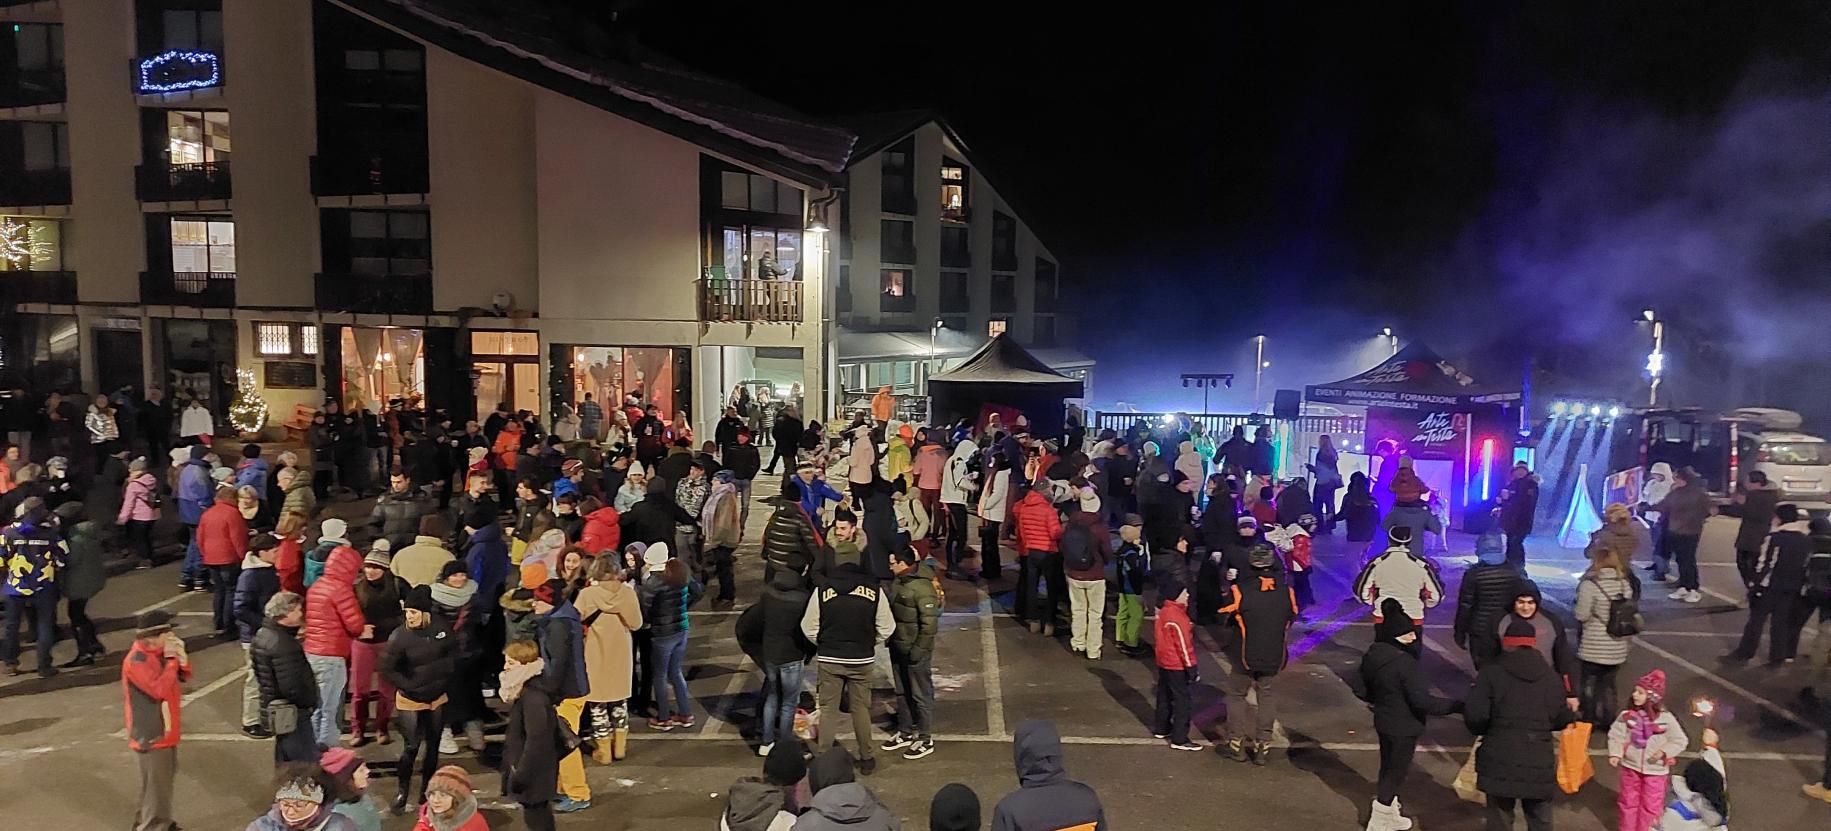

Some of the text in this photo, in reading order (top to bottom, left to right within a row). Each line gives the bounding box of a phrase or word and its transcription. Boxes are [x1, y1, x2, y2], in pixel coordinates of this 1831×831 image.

[1314, 388, 1457, 405] EVENTI ANIMAZIONE FORMAZIONE
[1417, 411, 1450, 429] Arte
[1424, 425, 1457, 447] Testa
